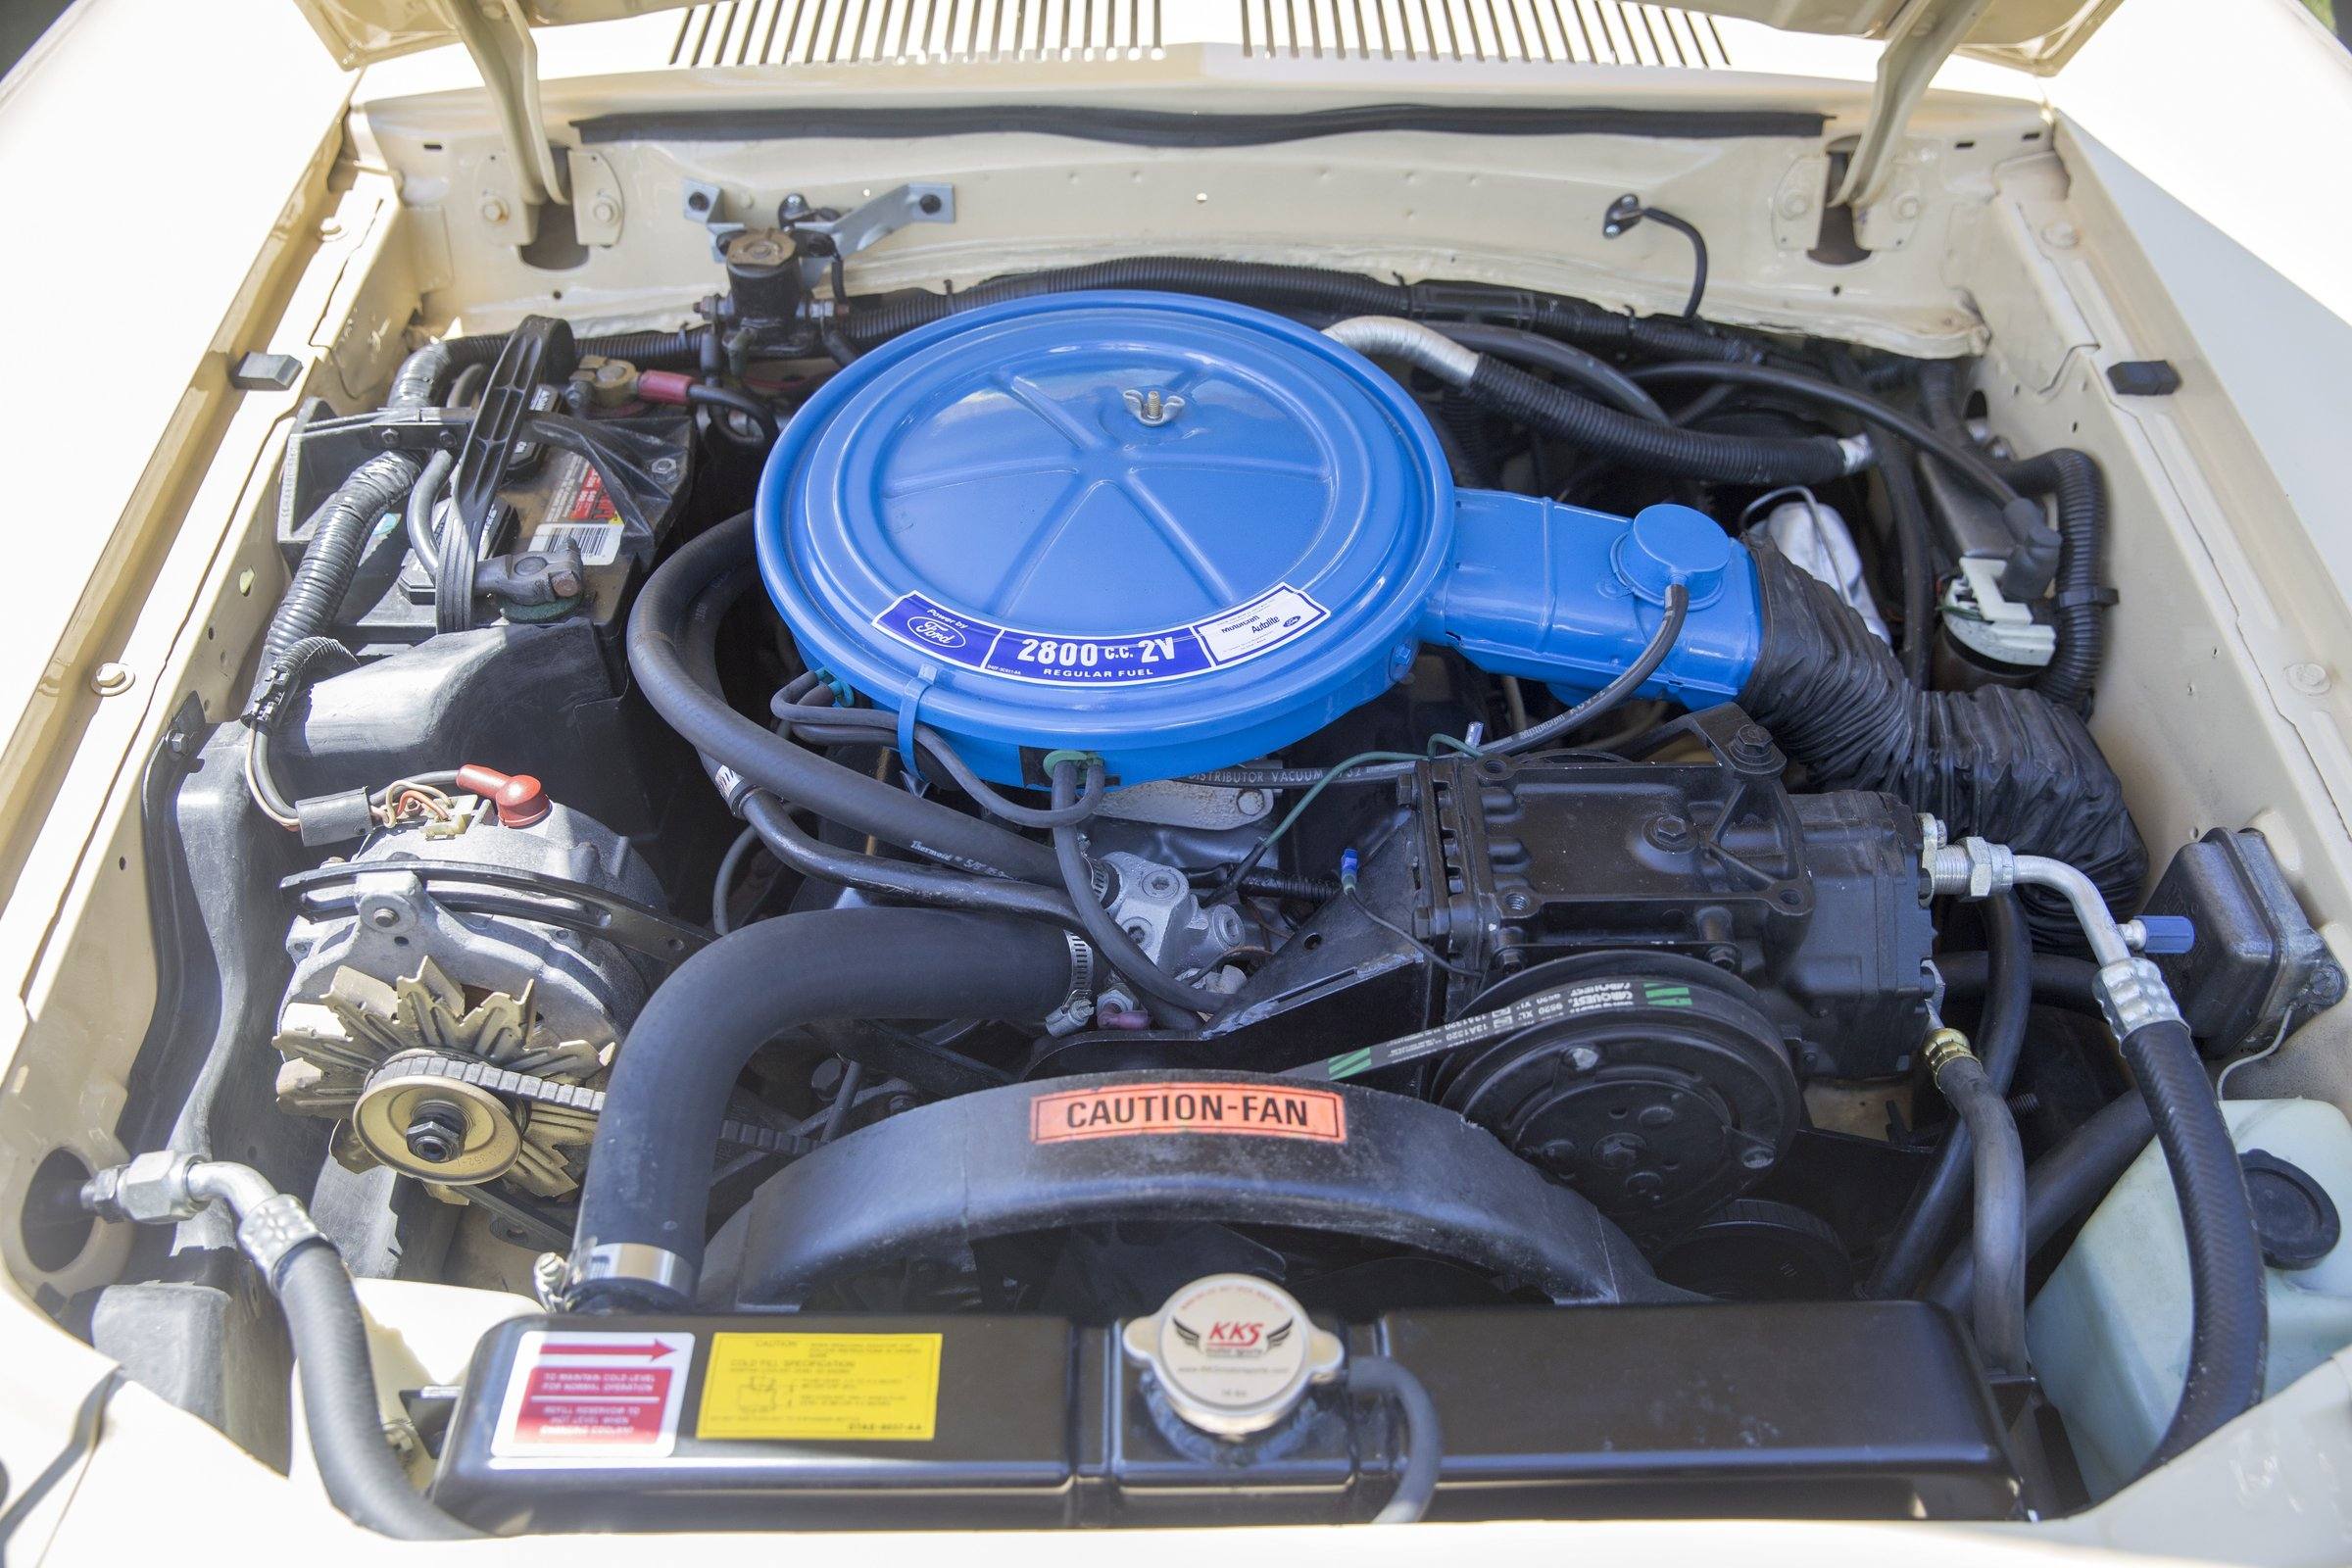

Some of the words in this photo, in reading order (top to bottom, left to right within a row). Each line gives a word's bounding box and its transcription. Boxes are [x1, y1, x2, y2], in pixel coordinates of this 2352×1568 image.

[927, 609, 956, 624] Power
[955, 620, 968, 629] by
[1251, 615, 1280, 633] Autolite
[915, 620, 955, 644] Ford
[1016, 638, 1098, 667] 2800
[1138, 636, 1176, 663] 2V
[1043, 668, 1112, 678] REGULAR
[1118, 668, 1153, 677] FUEL
[1271, 769, 1324, 783] VACUUM
[1066, 1093, 1308, 1129] CAUTION-FAN
[1207, 1321, 1265, 1347] KKS
